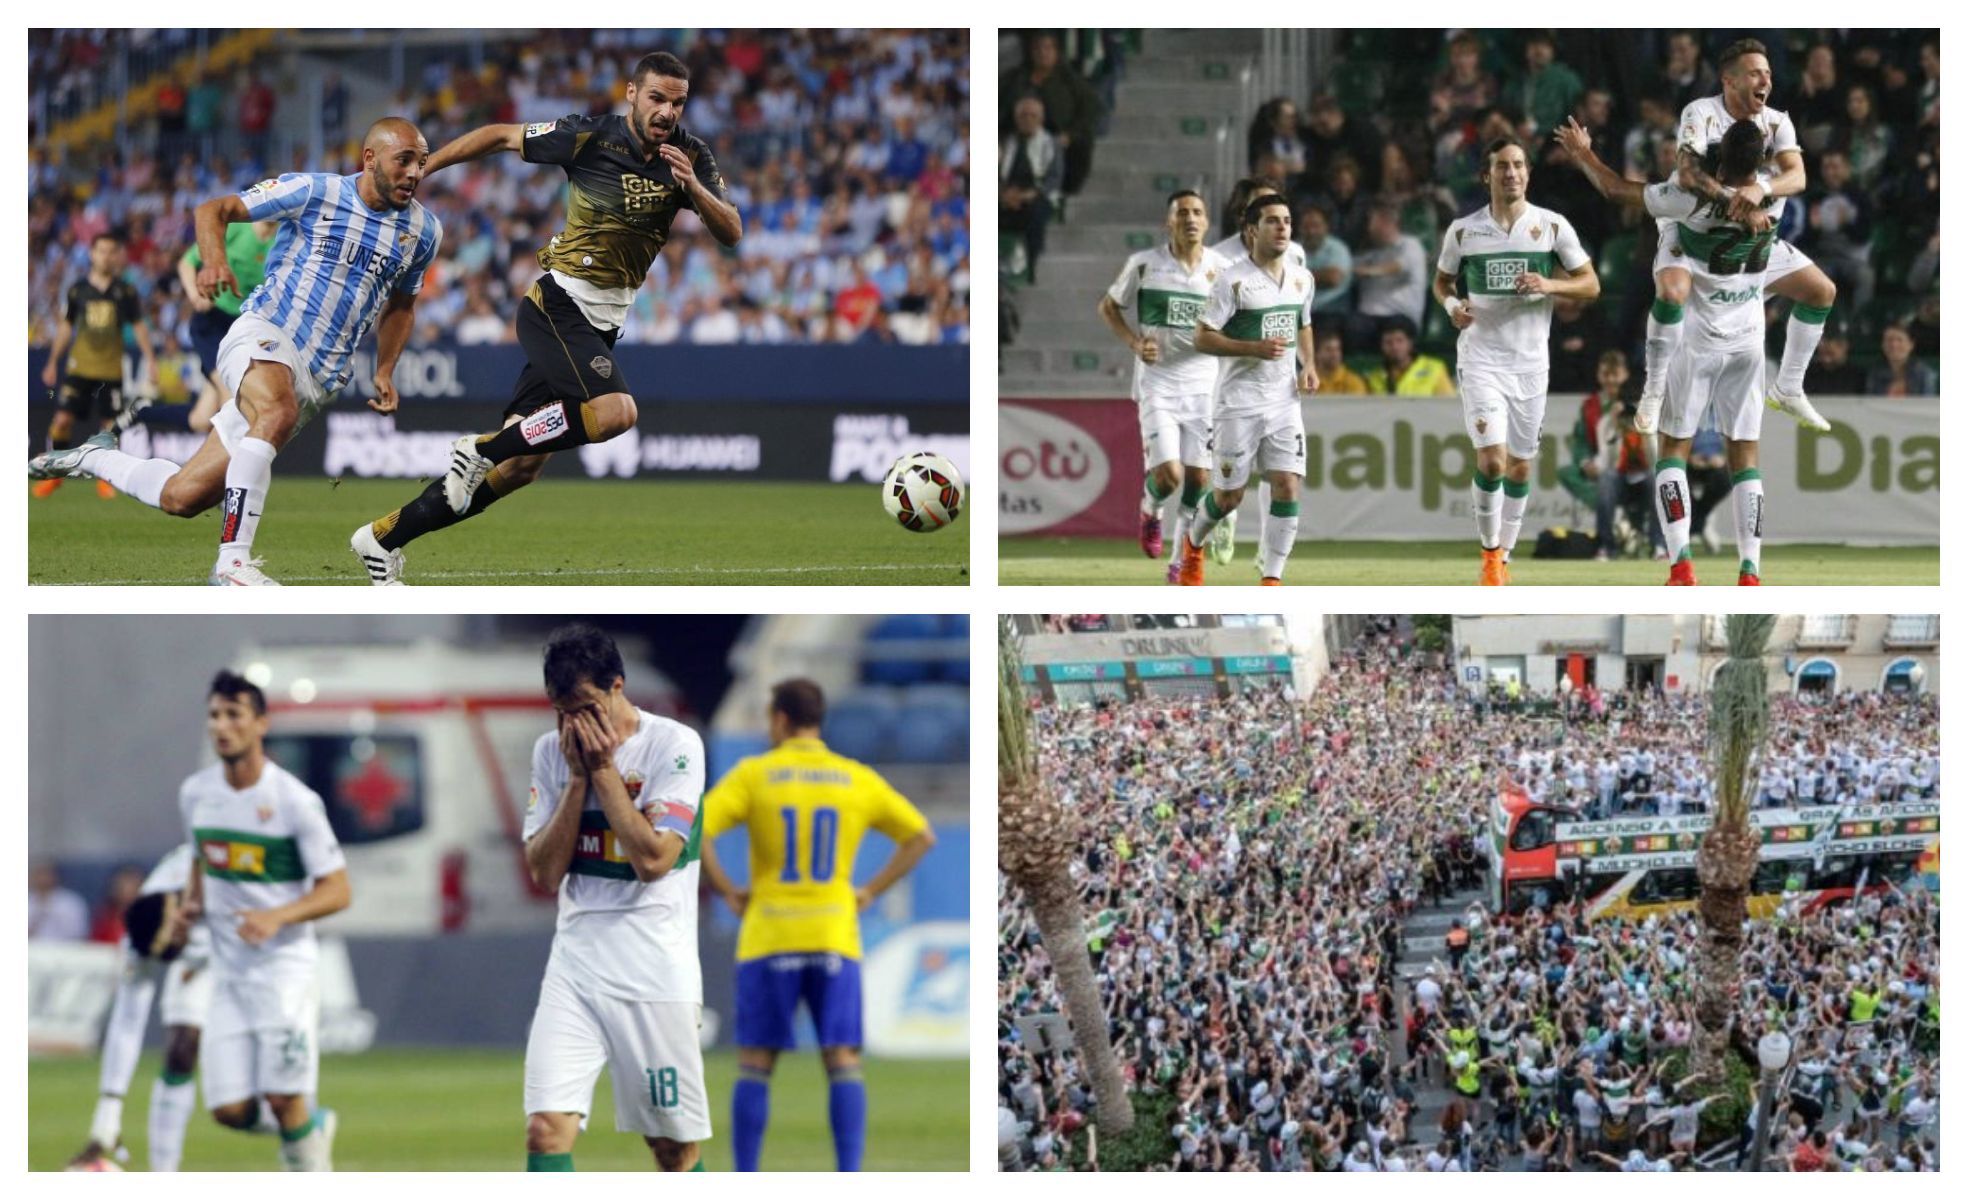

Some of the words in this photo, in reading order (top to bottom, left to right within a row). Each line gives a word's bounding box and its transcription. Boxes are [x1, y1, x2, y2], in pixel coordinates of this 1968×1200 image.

[1490, 263, 1524, 274] GIOS
[1264, 314, 1295, 330] GIOS
[780, 806, 838, 884] 10
[646, 1066, 679, 1108] 18
